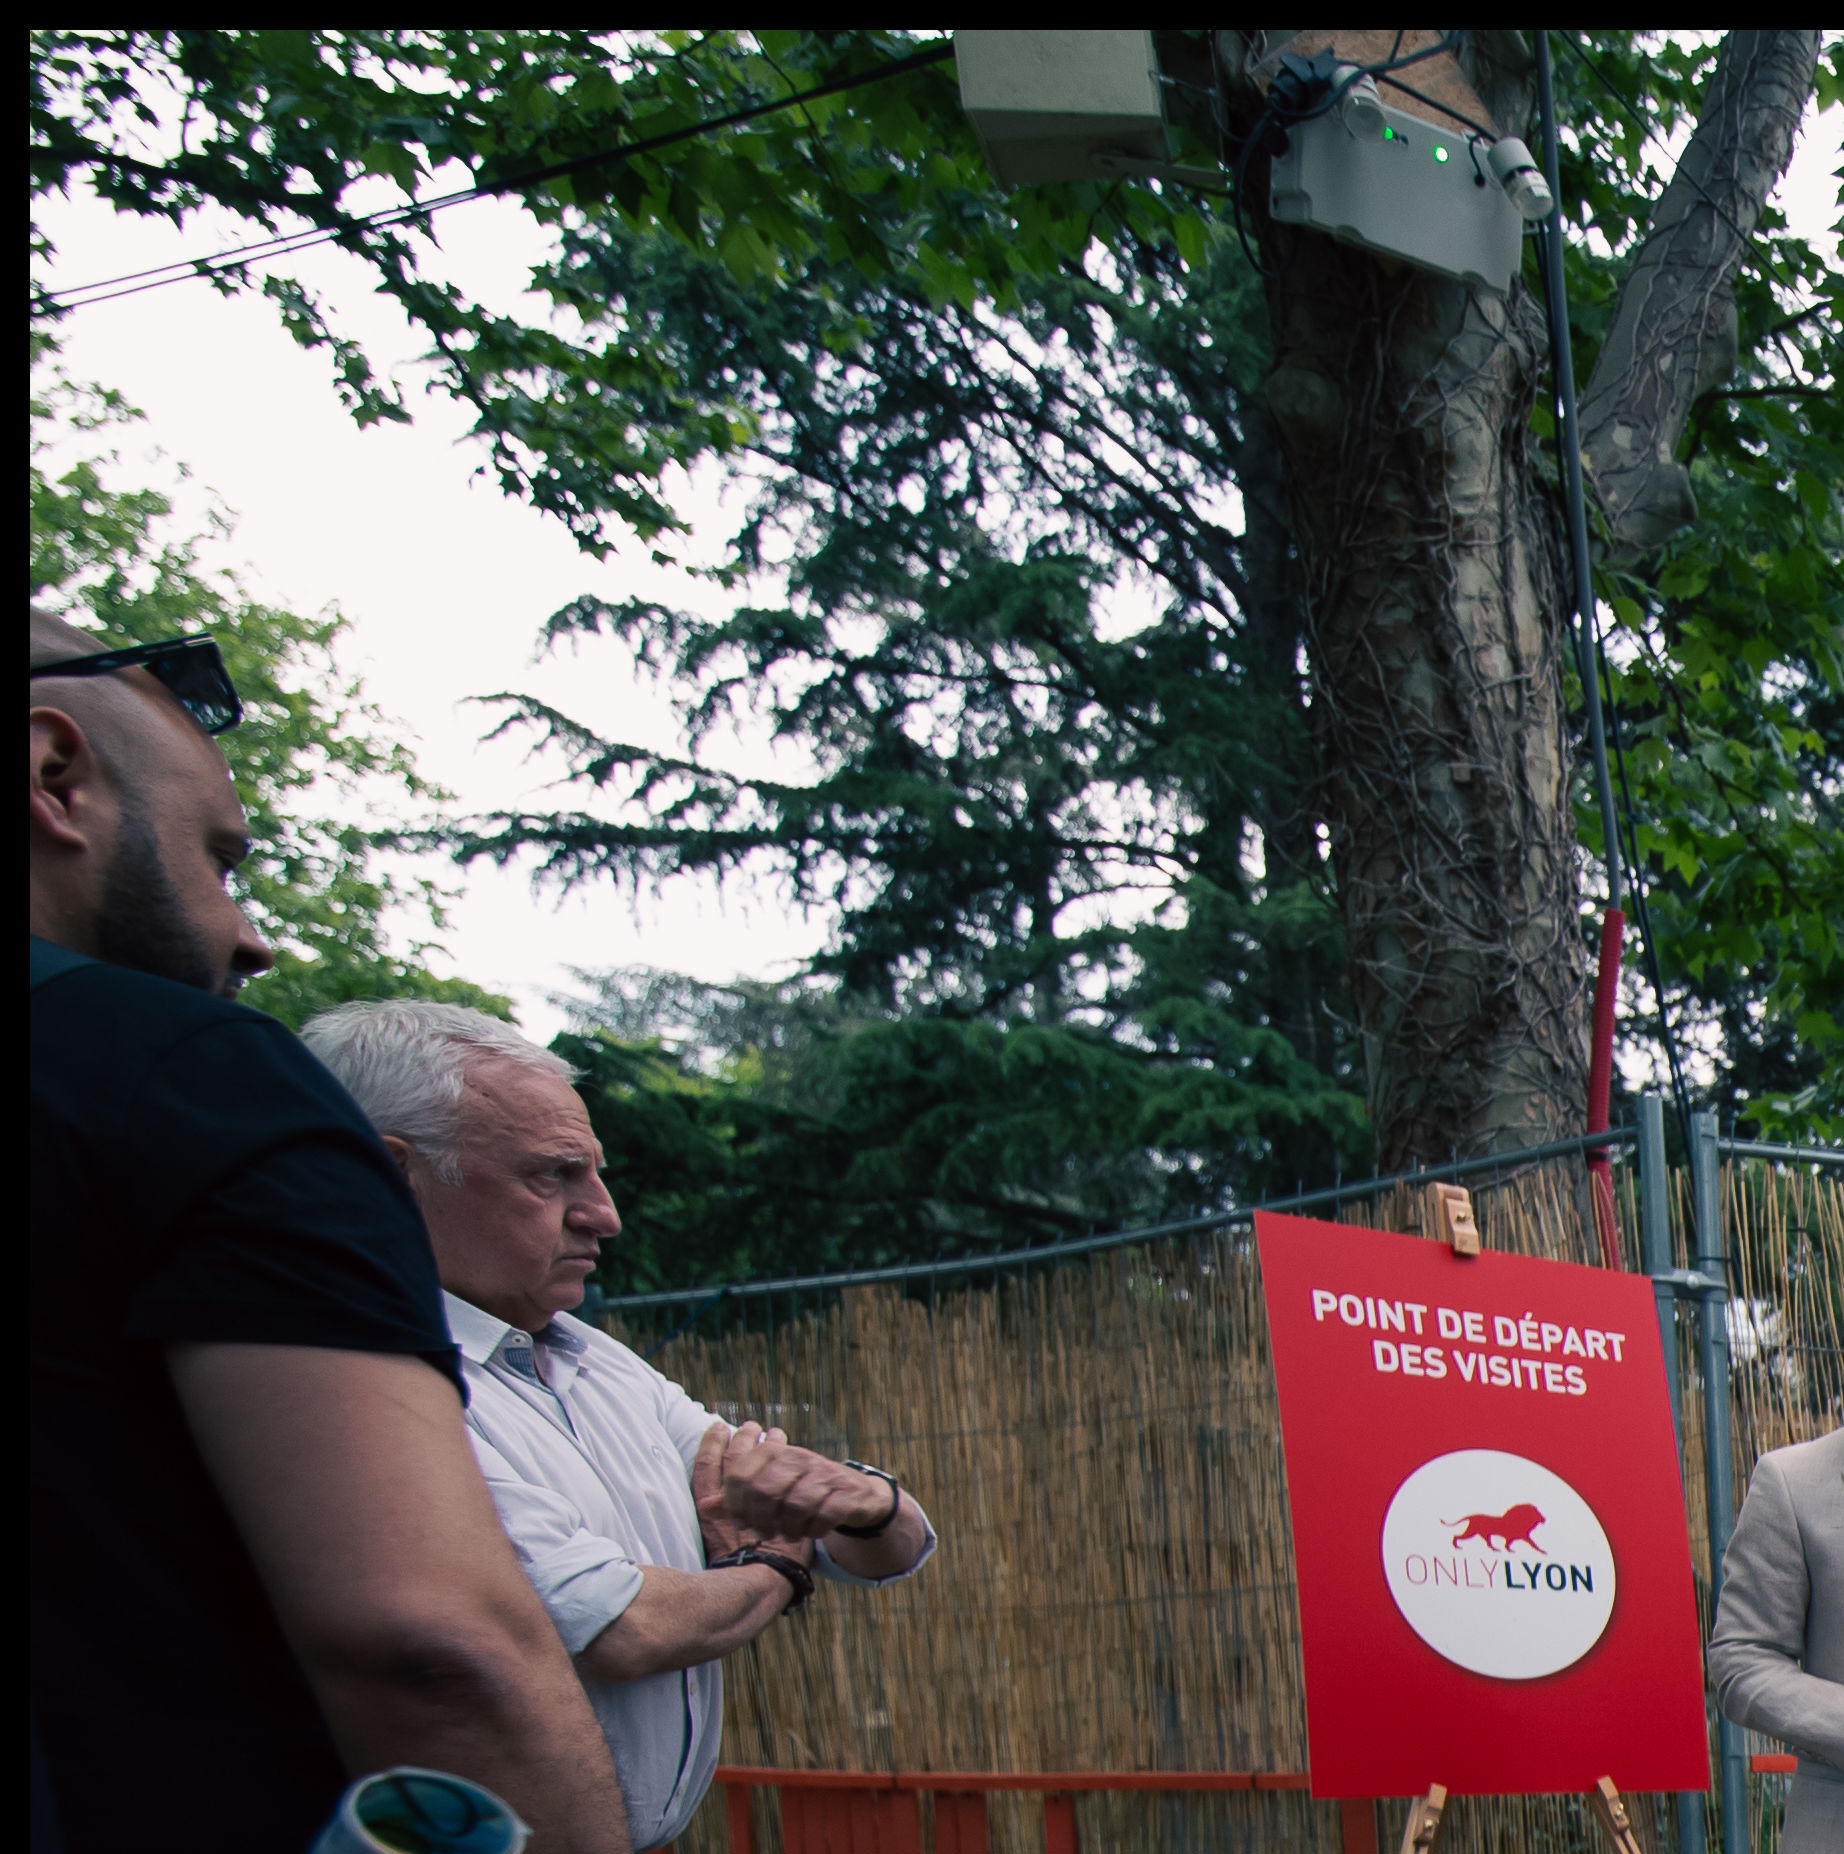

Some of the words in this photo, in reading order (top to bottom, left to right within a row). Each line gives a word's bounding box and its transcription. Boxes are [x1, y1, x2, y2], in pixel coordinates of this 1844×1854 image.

[1310, 1288, 1428, 1336] POINT
[1436, 1306, 1487, 1344] DE
[1492, 1311, 1626, 1363] DÉPART
[1371, 1339, 1448, 1379] DES
[1452, 1349, 1588, 1396] VISITES
